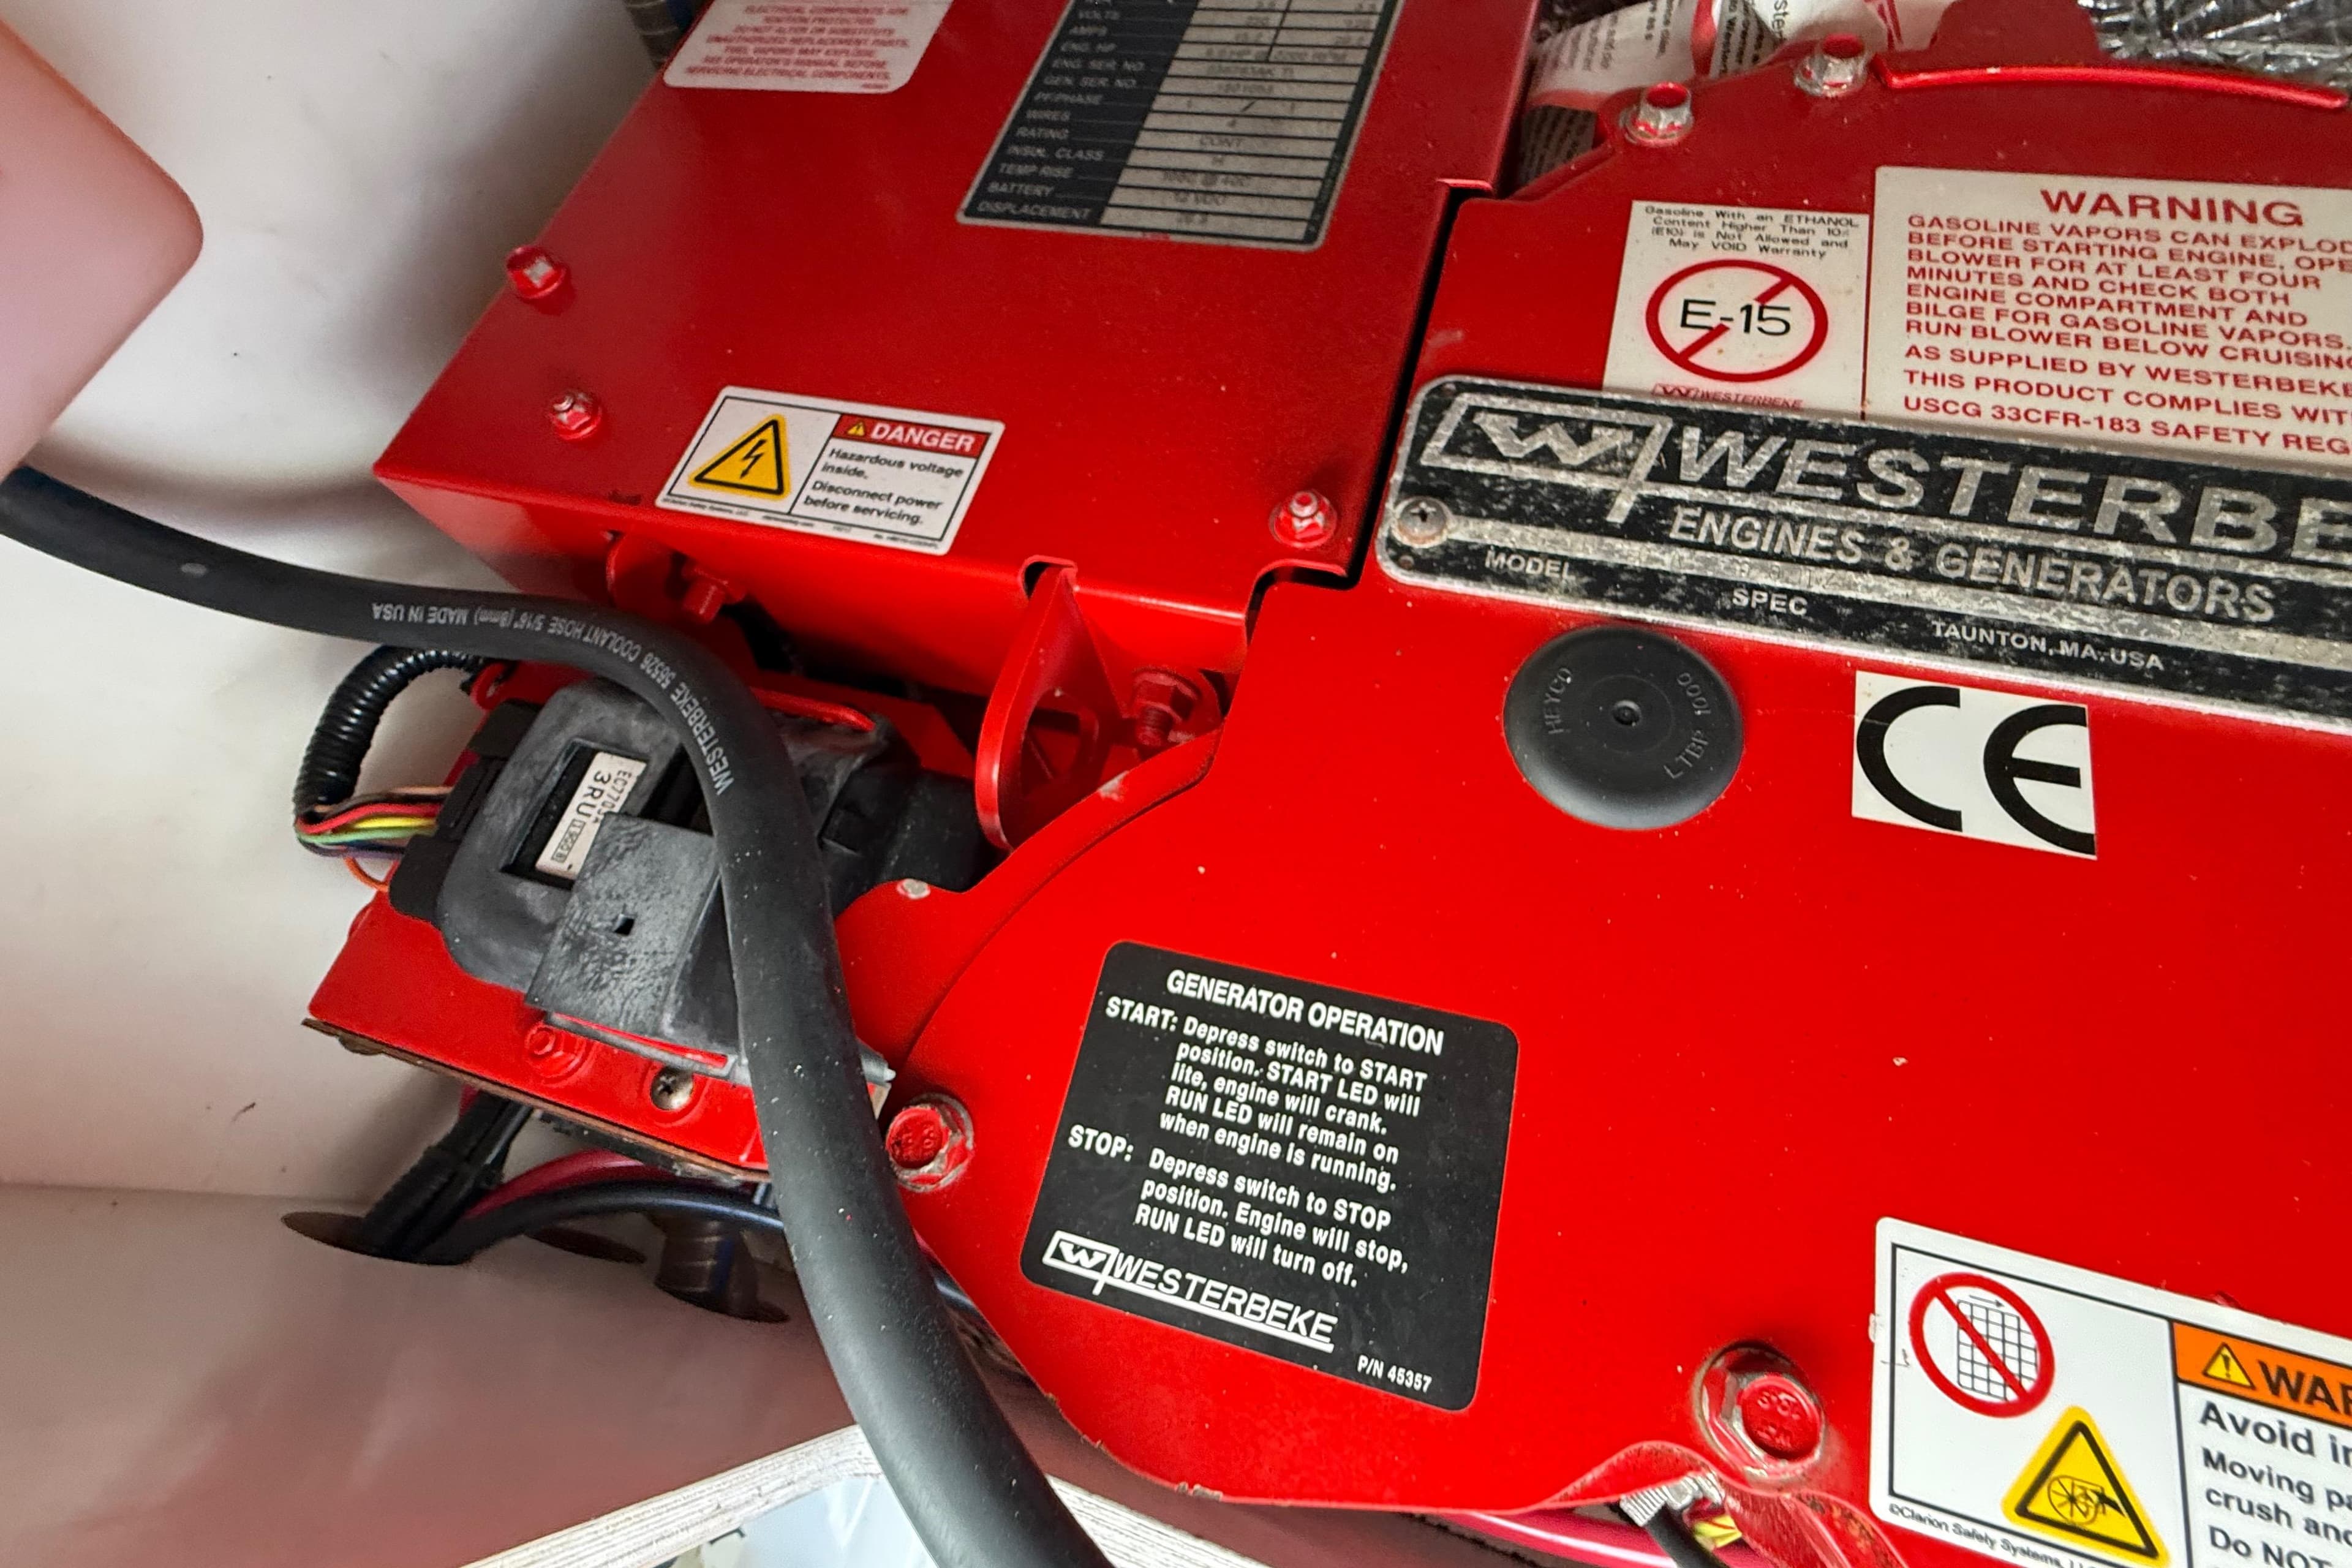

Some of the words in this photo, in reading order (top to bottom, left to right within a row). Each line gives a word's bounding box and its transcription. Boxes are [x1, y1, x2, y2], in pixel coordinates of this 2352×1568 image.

[1645, 205, 1704, 217] Gasoline
[1716, 210, 1745, 219] With
[1784, 214, 1858, 228] ETHANOL
[1653, 216, 1710, 228] Content
[1722, 221, 1766, 233] Higher
[1781, 224, 1815, 235] Than
[2041, 189, 2305, 227] WARNING
[1669, 238, 1698, 249] May
[1711, 241, 1747, 251] VOID
[1758, 244, 1825, 259] Warranty
[1716, 230, 1741, 241] Not
[1755, 233, 1809, 246] Allowed
[1821, 240, 1848, 249] and
[1908, 216, 2039, 235] GASOLINE
[2051, 224, 2162, 243] VAPORS
[2170, 231, 2230, 246] CAN
[1908, 232, 2012, 251] BEFORE
[2023, 239, 2158, 260] STARTING
[2168, 248, 2284, 270] ENGINE,
[1907, 266, 2024, 287] MINUTES
[2032, 276, 2089, 291] AND
[2098, 281, 2196, 300] CHECK
[2208, 287, 2290, 306] BOTH
[1908, 249, 2021, 268] BLOWER
[2031, 257, 2085, 273] FOR
[2095, 262, 2126, 276] AT
[2138, 264, 2228, 282] LEAST
[2239, 271, 2320, 289] FOUR
[1680, 298, 1791, 336] E-15
[1907, 284, 2005, 303] ENGINE
[2015, 292, 2234, 320] COMPARTMENT
[2245, 309, 2307, 326] AND
[1906, 320, 1961, 337] RUN
[1972, 325, 2091, 348] BLOWER
[2103, 336, 2209, 358] BELOW
[2219, 345, 2352, 369] CRUISIN
[1907, 301, 1985, 320] BILGE
[1995, 309, 2049, 326] FOR
[2060, 314, 2208, 338] GASOLINE
[2218, 326, 2352, 350] VAPORS.
[1905, 345, 1940, 360] AS
[1950, 349, 2088, 374] SUPPLIED
[2098, 362, 2135, 378] BY
[1905, 370, 1965, 388] THIS
[1975, 377, 2113, 403] PRODUCT
[2124, 391, 2282, 420] COMPLIES
[2291, 406, 2352, 425] WIT
[870, 423, 975, 452] DANGER
[1903, 395, 1982, 418] USCG
[1991, 403, 2141, 434] 33CFR-183
[2152, 421, 2270, 448] SAFETY
[829, 448, 905, 469] Hazardous
[910, 462, 963, 478] voltage
[804, 495, 850, 511] before
[853, 505, 922, 526] servicing.
[812, 480, 894, 502] Disconnect
[894, 496, 942, 509] power
[1485, 549, 1576, 581] MODEL
[1670, 505, 1866, 564] ENGINES
[1884, 537, 1914, 572] &
[1935, 543, 2277, 623] GENERATORS
[371, 602, 405, 620] USA
[408, 604, 425, 623] IN
[428, 605, 469, 624] MADE
[1733, 588, 1808, 616] SPEC
[548, 621, 583, 641] HOSE
[581, 625, 643, 662] COOLANT
[2110, 647, 2165, 671] USA
[1544, 667, 1572, 734] HEYCO
[673, 681, 734, 796] WESTERBEKE
[1856, 685, 2097, 856] CE
[576, 770, 611, 818] 3RU
[1167, 970, 1305, 1023] GENERATOR
[1308, 1001, 1444, 1056] OPERATION
[1106, 996, 1178, 1031] START:
[1183, 1016, 1260, 1052] Depress
[1264, 1039, 1328, 1069] switch
[1333, 1053, 1354, 1075] to
[1359, 1058, 1428, 1092] START
[1170, 1061, 1207, 1091] lite,
[1213, 1076, 1280, 1115] engine
[1285, 1094, 1321, 1117] will
[1325, 1104, 1387, 1135] crank.
[1175, 1042, 1262, 1077] position.
[1266, 1061, 1333, 1094] START
[1336, 1078, 1378, 1106] LED
[1384, 1093, 1420, 1117] will
[1165, 1085, 1208, 1114] RUN
[1212, 1097, 1253, 1125] LED
[1258, 1112, 1294, 1136] will
[1297, 1123, 1366, 1156] remain
[1373, 1143, 1399, 1164] on
[1160, 1112, 1210, 1140] when
[1214, 1128, 1282, 1159] engine
[1286, 1142, 1305, 1166] is
[1311, 1153, 1396, 1194] running.
[1068, 1125, 1134, 1162] STOP:
[1148, 1148, 1229, 1188] Depress
[1234, 1175, 1300, 1208] switch
[1306, 1191, 1327, 1216] to
[1333, 1198, 1391, 1232] STOP
[1134, 1203, 1180, 1235] RUN
[1183, 1216, 1226, 1248] LED
[1231, 1234, 1268, 1261] will
[1273, 1243, 1316, 1275] turn
[1322, 1261, 1357, 1287] off.
[1140, 1179, 1228, 1219] position.
[1235, 1201, 1306, 1240] Engine
[1313, 1227, 1350, 1253] will
[1355, 1239, 1408, 1274] stop,
[1110, 1248, 1338, 1344] WESTERBEKE
[1357, 1355, 1384, 1379] P/N
[1387, 1365, 1432, 1393] 45357
[2199, 1400, 2316, 1458] Avoid
[2202, 1446, 2315, 1505] Moving
[2205, 1488, 2293, 1529] crush
[1951, 1521, 1998, 1551] Safety
[2208, 1525, 2252, 1558] Do
